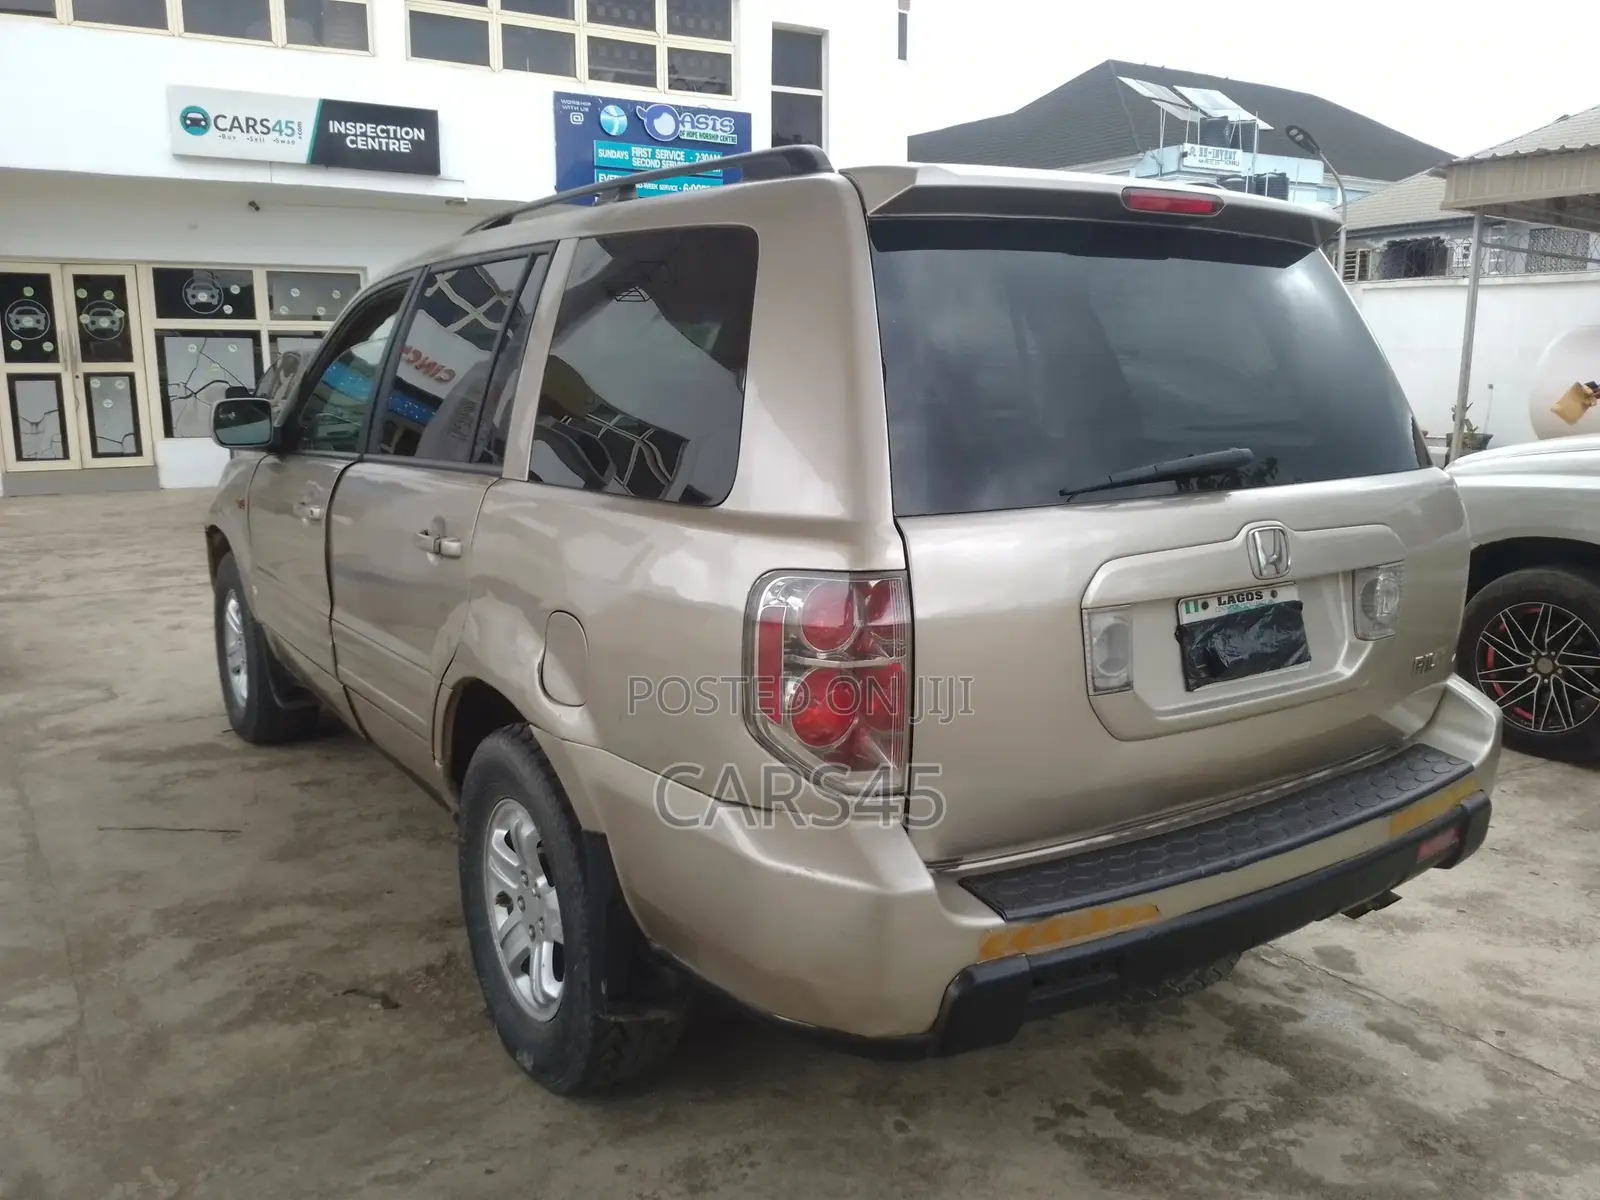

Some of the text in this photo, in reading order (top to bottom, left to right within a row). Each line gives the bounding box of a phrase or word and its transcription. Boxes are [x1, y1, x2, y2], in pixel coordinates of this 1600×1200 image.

[213, 113, 296, 138] CARS45
[328, 120, 425, 141] INSPECTION
[346, 136, 411, 152] CENTRE
[598, 148, 629, 160] SUNDAYS
[631, 146, 652, 158] FIRST
[655, 148, 685, 161] SERVICE
[631, 157, 691, 169] SECOND SERV
[1217, 590, 1264, 606] LAGOS
